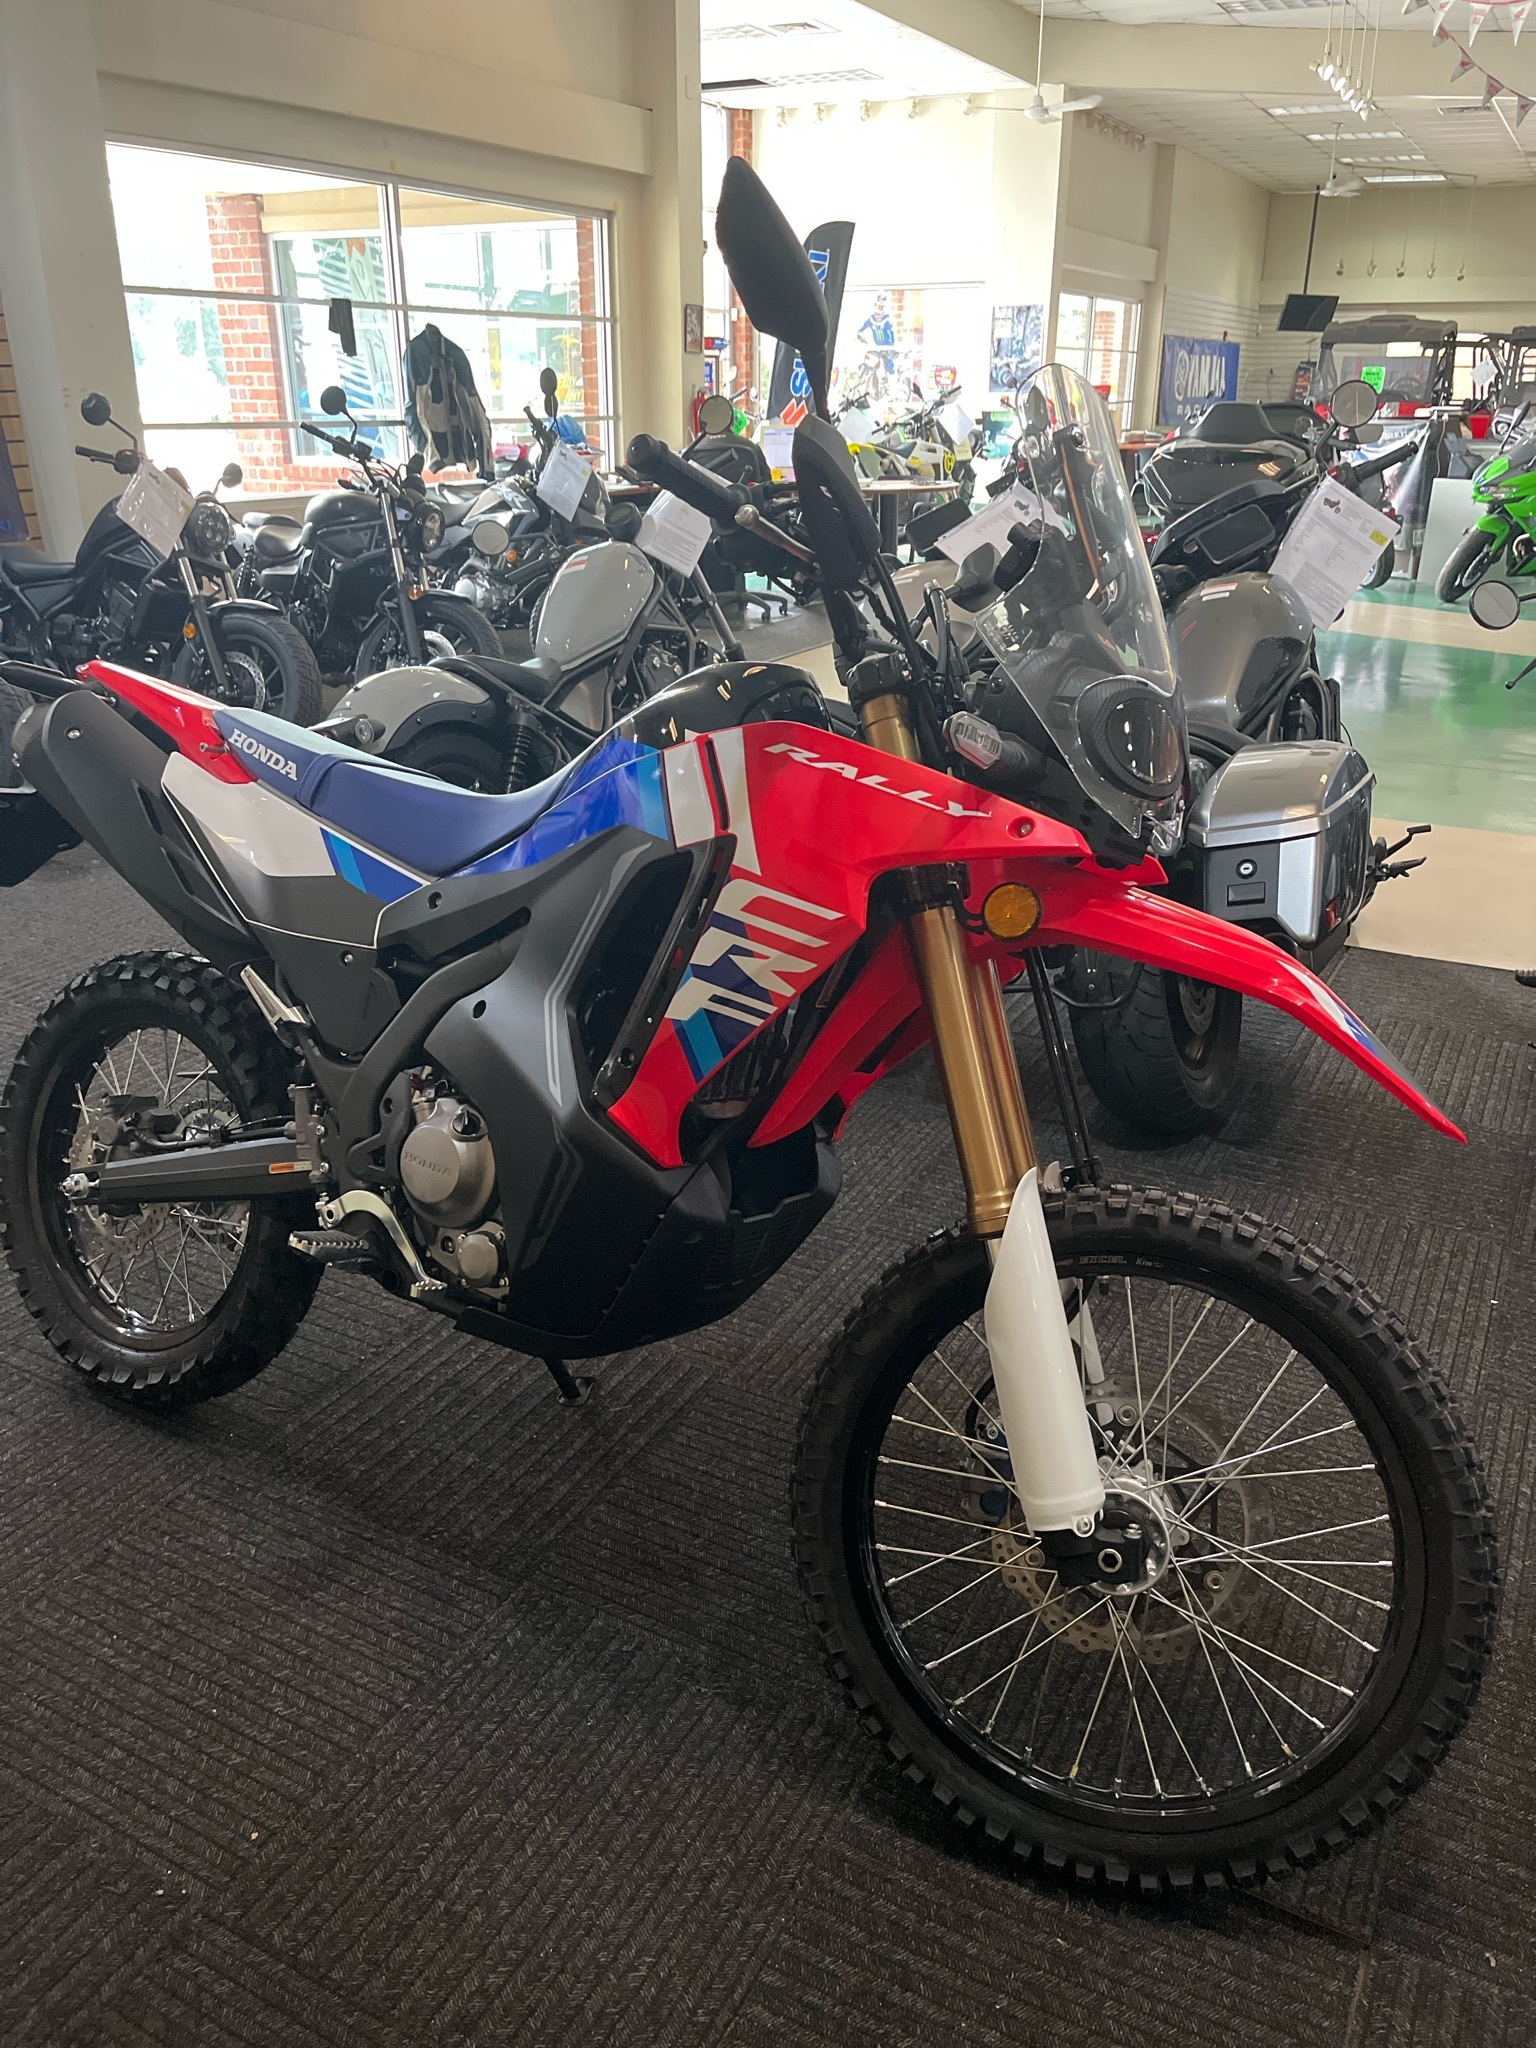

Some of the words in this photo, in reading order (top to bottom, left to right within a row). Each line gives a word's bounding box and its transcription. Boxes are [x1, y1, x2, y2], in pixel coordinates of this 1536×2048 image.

[228, 728, 298, 781] HONDA
[763, 743, 992, 818] RALLY
[1079, 1255, 1128, 1265] EXCEL
[1135, 1257, 1153, 1267] Rim
